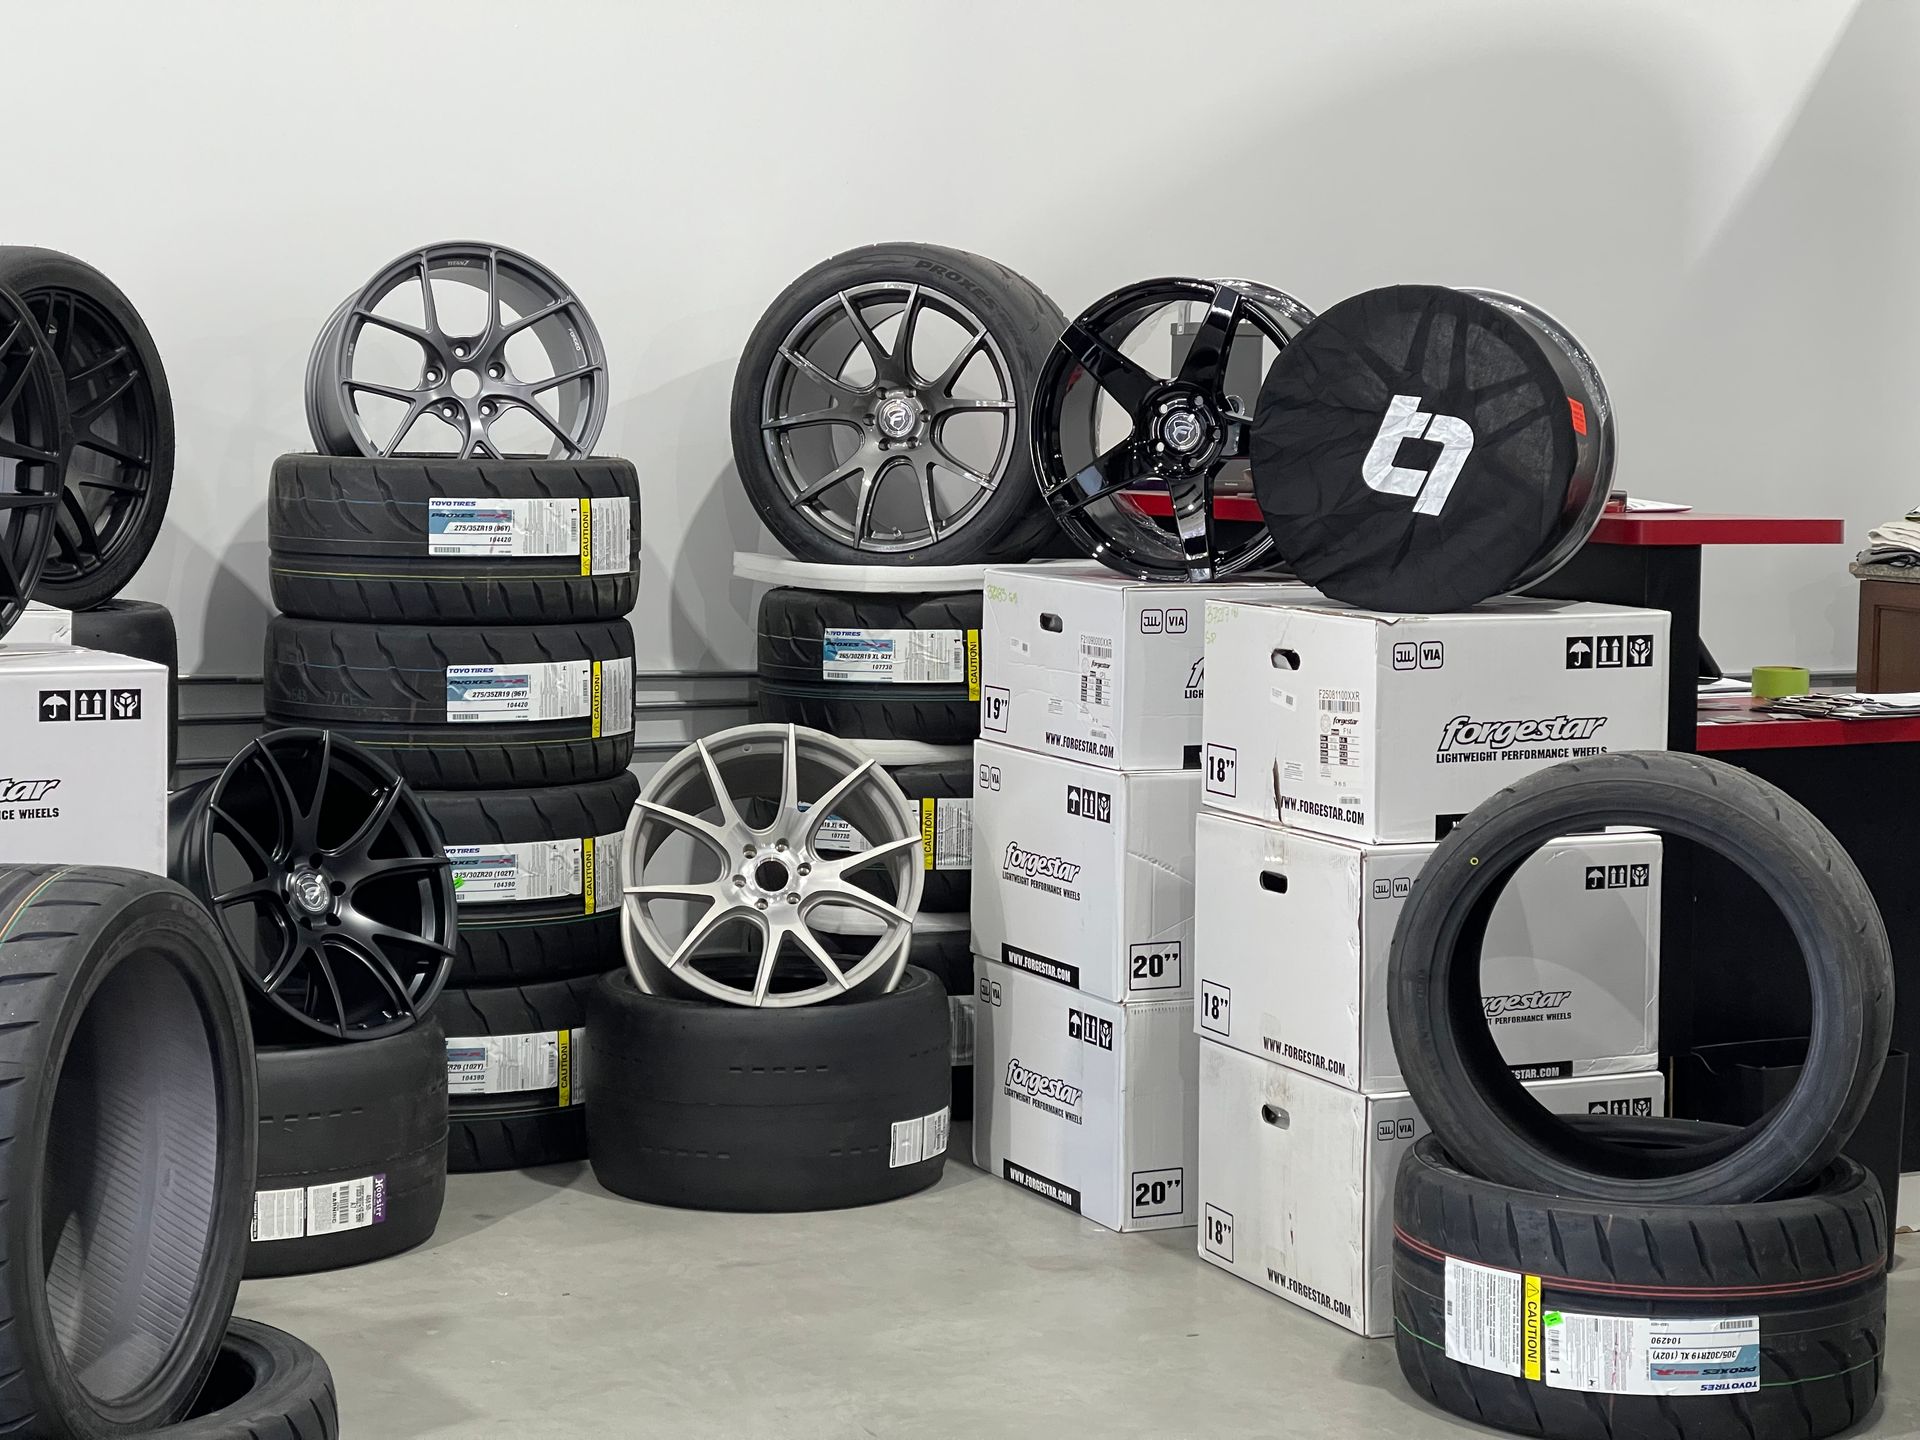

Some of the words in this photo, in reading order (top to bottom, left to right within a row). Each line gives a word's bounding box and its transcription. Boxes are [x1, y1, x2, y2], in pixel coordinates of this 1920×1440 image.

[914, 260, 995, 310] PROXES
[1169, 616, 1184, 627] VIA
[1423, 649, 1440, 661] VIA
[1332, 716, 1359, 726] forgestar
[1437, 715, 1608, 752] forgestar
[1045, 732, 1114, 758] WWW.FORGESTAR.COM
[1436, 751, 1497, 764] LIGHTWEIGHT
[1502, 748, 1569, 760] PERFORMANCE
[1572, 746, 1607, 757] WHEELS
[19, 808, 59, 820] WHEELS
[1274, 796, 1365, 826] WWW.FORGESTAR.COM
[1003, 841, 1081, 883] forgestar
[1002, 871, 1030, 887] LIGHTWEIGHT
[1030, 877, 1062, 897] PERFORMANCE
[1063, 889, 1081, 901] WHEELS
[1395, 883, 1408, 893] VIA
[1008, 950, 1071, 983] WWW.FORGESTAR.COM
[1482, 991, 1571, 1017] rgestar
[1495, 1014, 1544, 1024] PERFORMANCE
[1546, 1012, 1572, 1020] WHEELS
[1263, 1036, 1346, 1076] WWW.FORGESTAR.COM
[1005, 1058, 1083, 1106] forgestar
[1004, 1086, 1031, 1105] LIGHTWEIGHT
[1032, 1097, 1064, 1119] PERFORMANCE
[1065, 1111, 1082, 1125] WHEELS
[1400, 1124, 1412, 1134] VIA
[375, 1178, 384, 1217] Hoosier
[1010, 1168, 1072, 1206] WWW.FORGESTAR.COM
[1267, 1268, 1352, 1319] WWW.FORGESTAR.COM
[1526, 1300, 1538, 1364] CAUTION!
[1652, 1352, 1678, 1360] (102Y)
[1681, 1352, 1691, 1360] XL
[1692, 1350, 1737, 1359] 305/30ZR19
[1702, 1366, 1756, 1376] PROXES
[1700, 1384, 1730, 1392] TIRES
